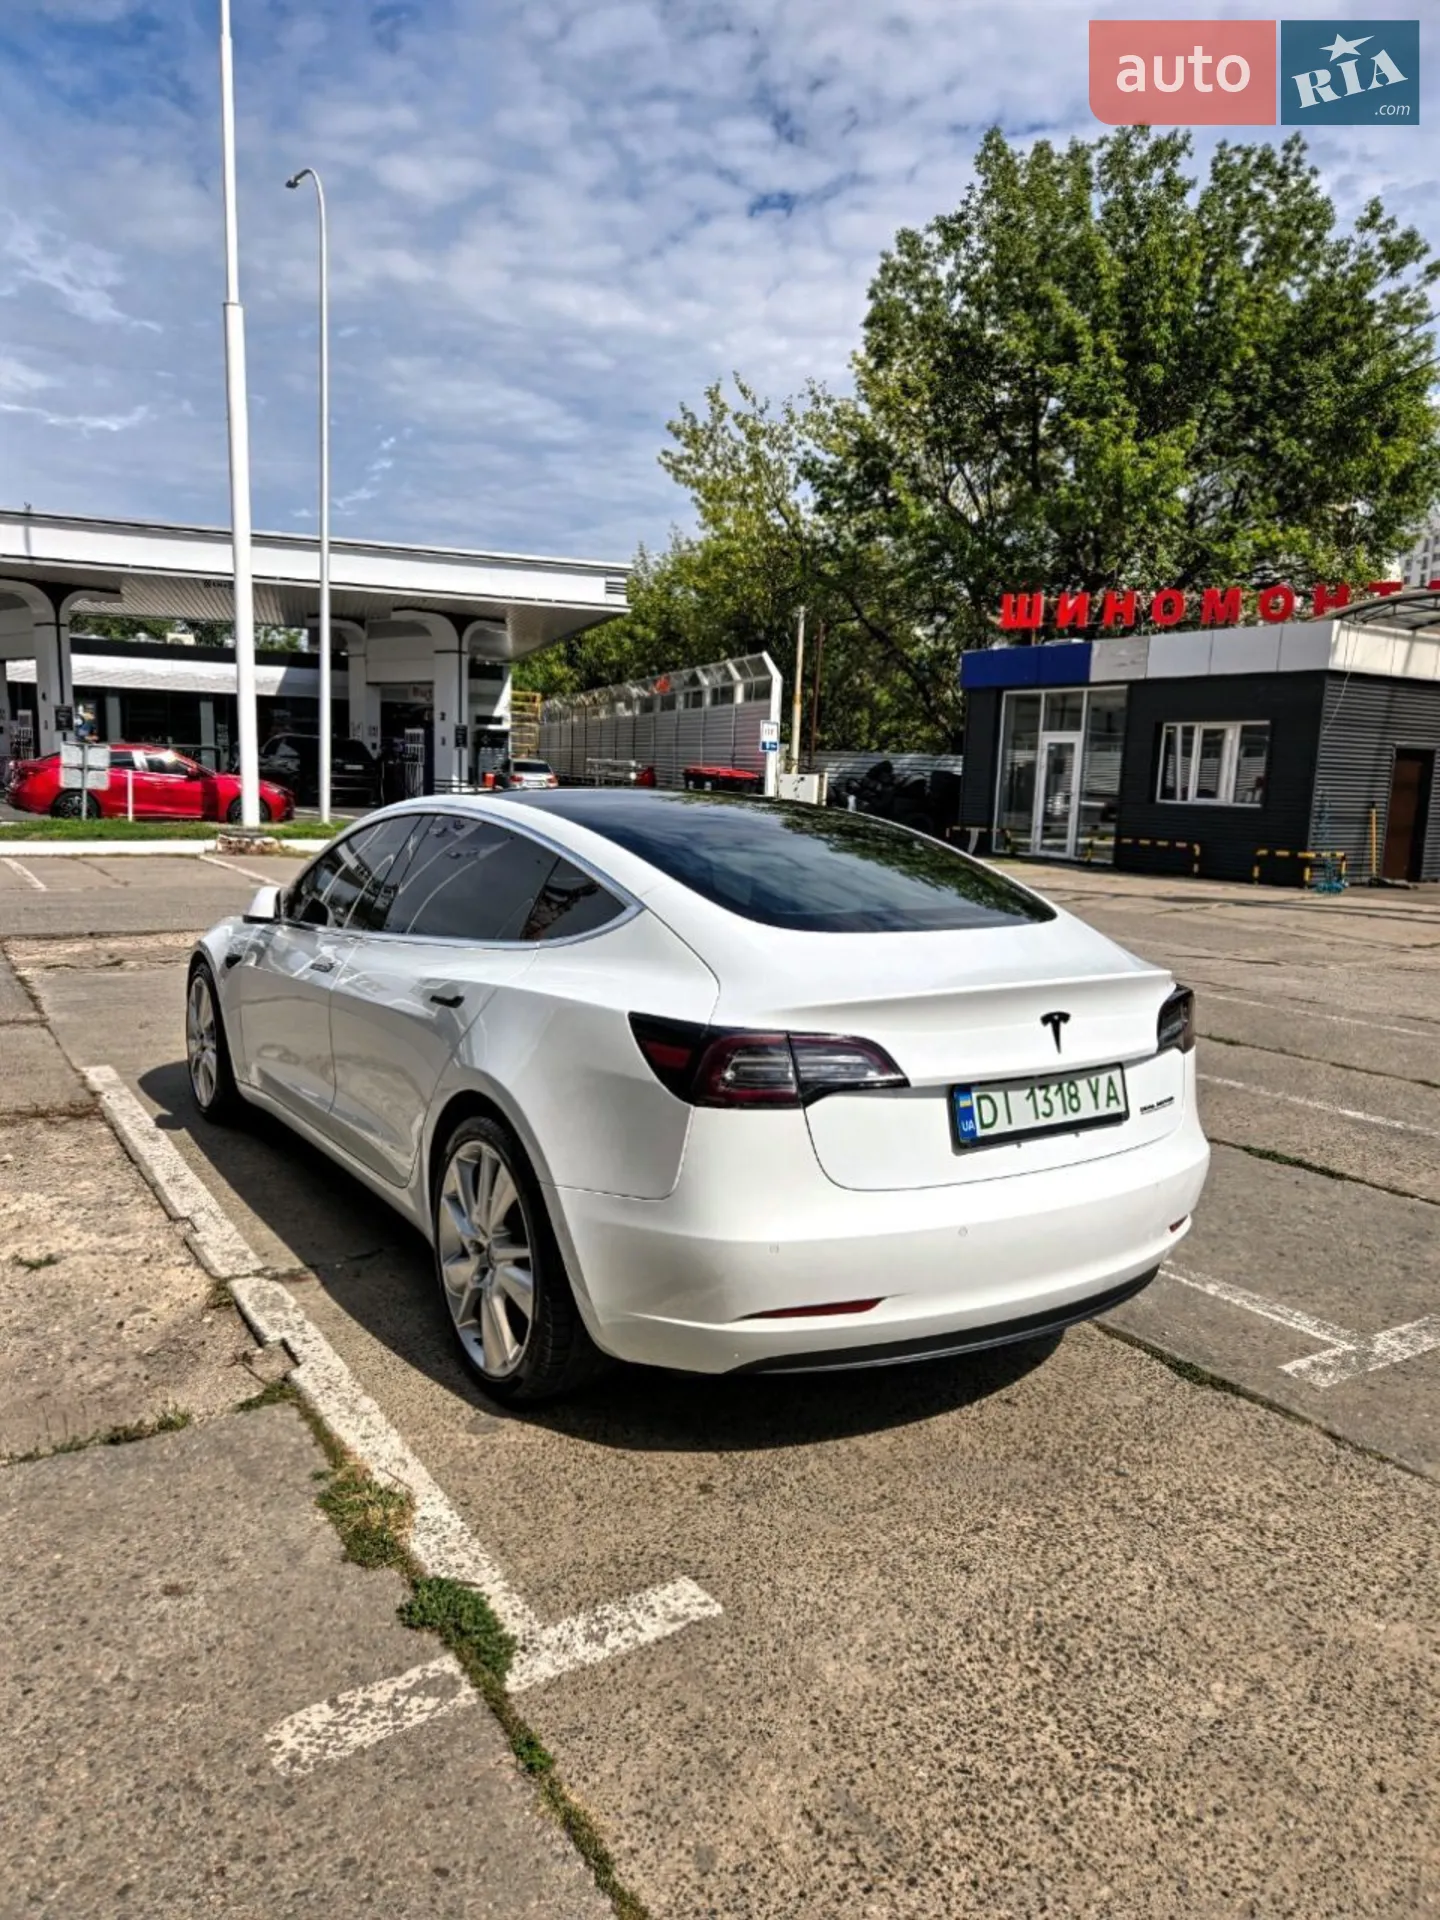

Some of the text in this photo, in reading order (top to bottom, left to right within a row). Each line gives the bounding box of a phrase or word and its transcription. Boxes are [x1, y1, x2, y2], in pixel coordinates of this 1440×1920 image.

[1000, 580, 1440, 629] ШИНОМОНТ
[961, 1121, 976, 1132] UA
[976, 1075, 1121, 1130] DI 1318 YA
